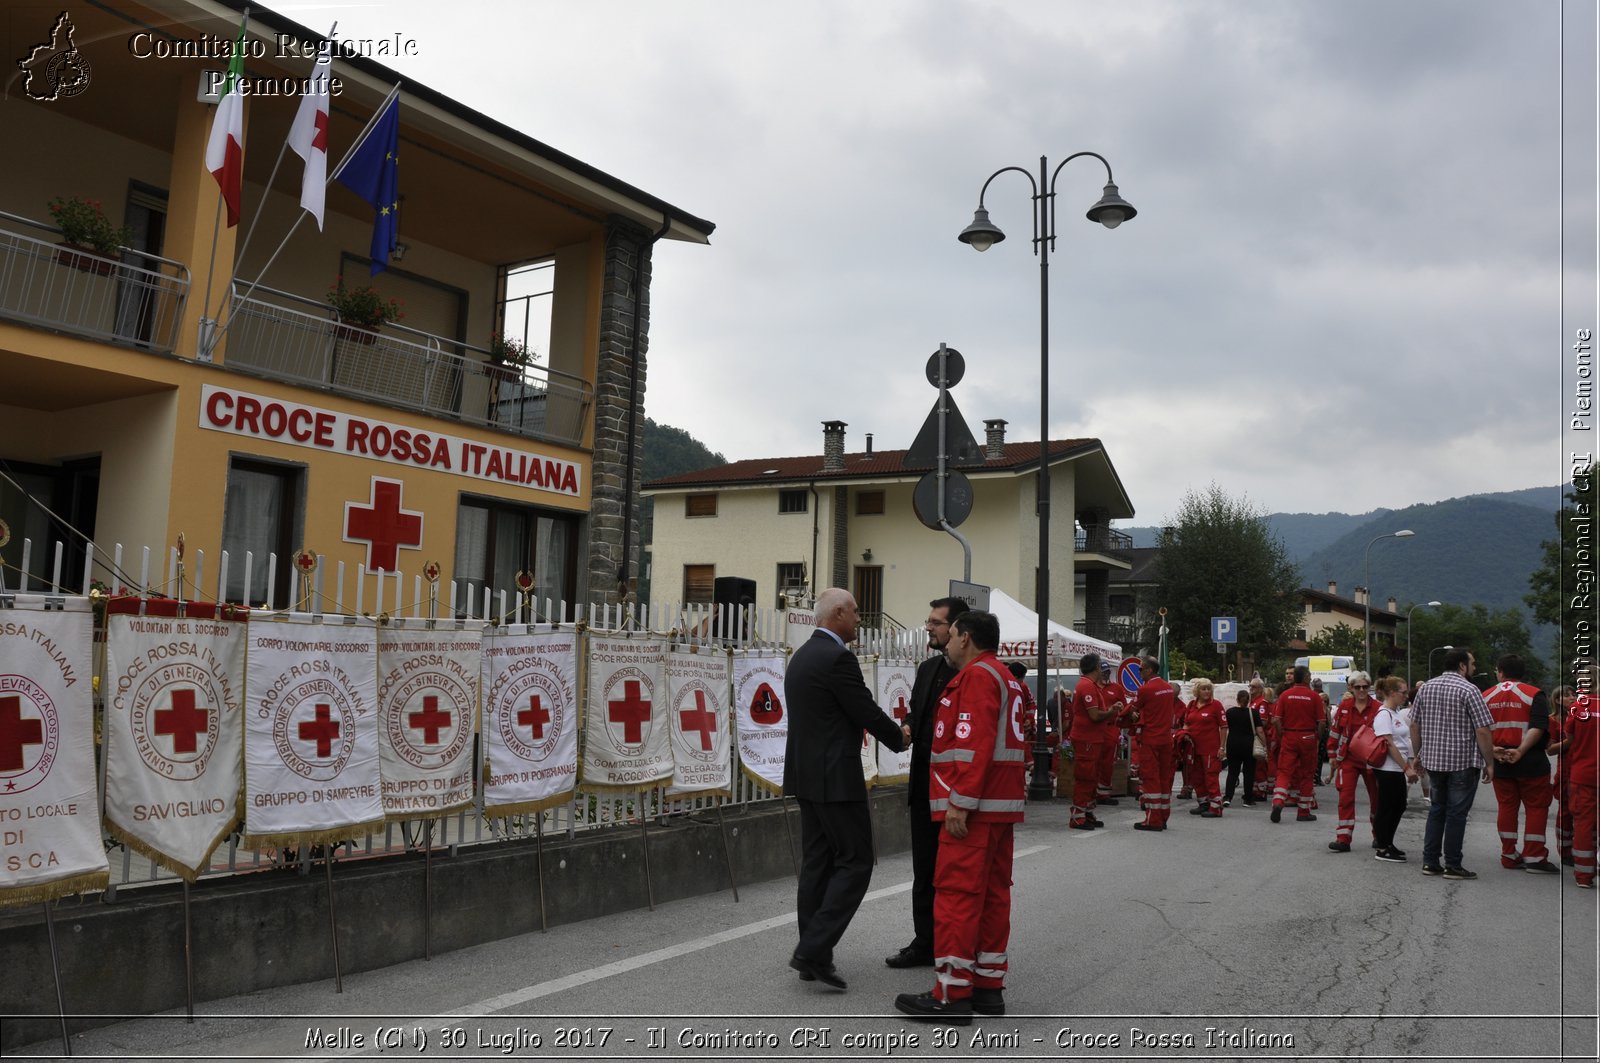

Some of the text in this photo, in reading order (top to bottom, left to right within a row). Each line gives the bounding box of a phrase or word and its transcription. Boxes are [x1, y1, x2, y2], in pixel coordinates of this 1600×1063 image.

[206, 391, 578, 493] CROCE ROSSA ITALIANA
[130, 621, 172, 635] VOLONTARI
[177, 623, 191, 635] DEL
[1218, 619, 1230, 640] P
[257, 638, 283, 650] CORPO
[31, 628, 77, 689] ITALIANA
[402, 654, 443, 674] ROSSA
[508, 656, 543, 676] ROSSA
[147, 642, 198, 664] ROSSA
[201, 648, 237, 713] ITALIANA
[258, 673, 290, 720] CROCE
[333, 666, 367, 717] ITALIANA
[31, 689, 45, 704] 22
[42, 702, 58, 750] AGOSTO
[134, 692, 174, 776] CONVENZIONE
[163, 666, 211, 689] GINEVRA
[275, 706, 312, 777] CONVENZIONE
[389, 698, 423, 764] CONVENZIONE
[434, 779, 446, 790] DI
[489, 773, 519, 787] GRUPPO
[521, 772, 529, 783] DI
[254, 785, 375, 807] GRUPPO DI SAMPEYRE
[28, 804, 77, 819] LOCALE
[133, 798, 225, 821] SAVIGLIANO
[4, 830, 23, 846] DI
